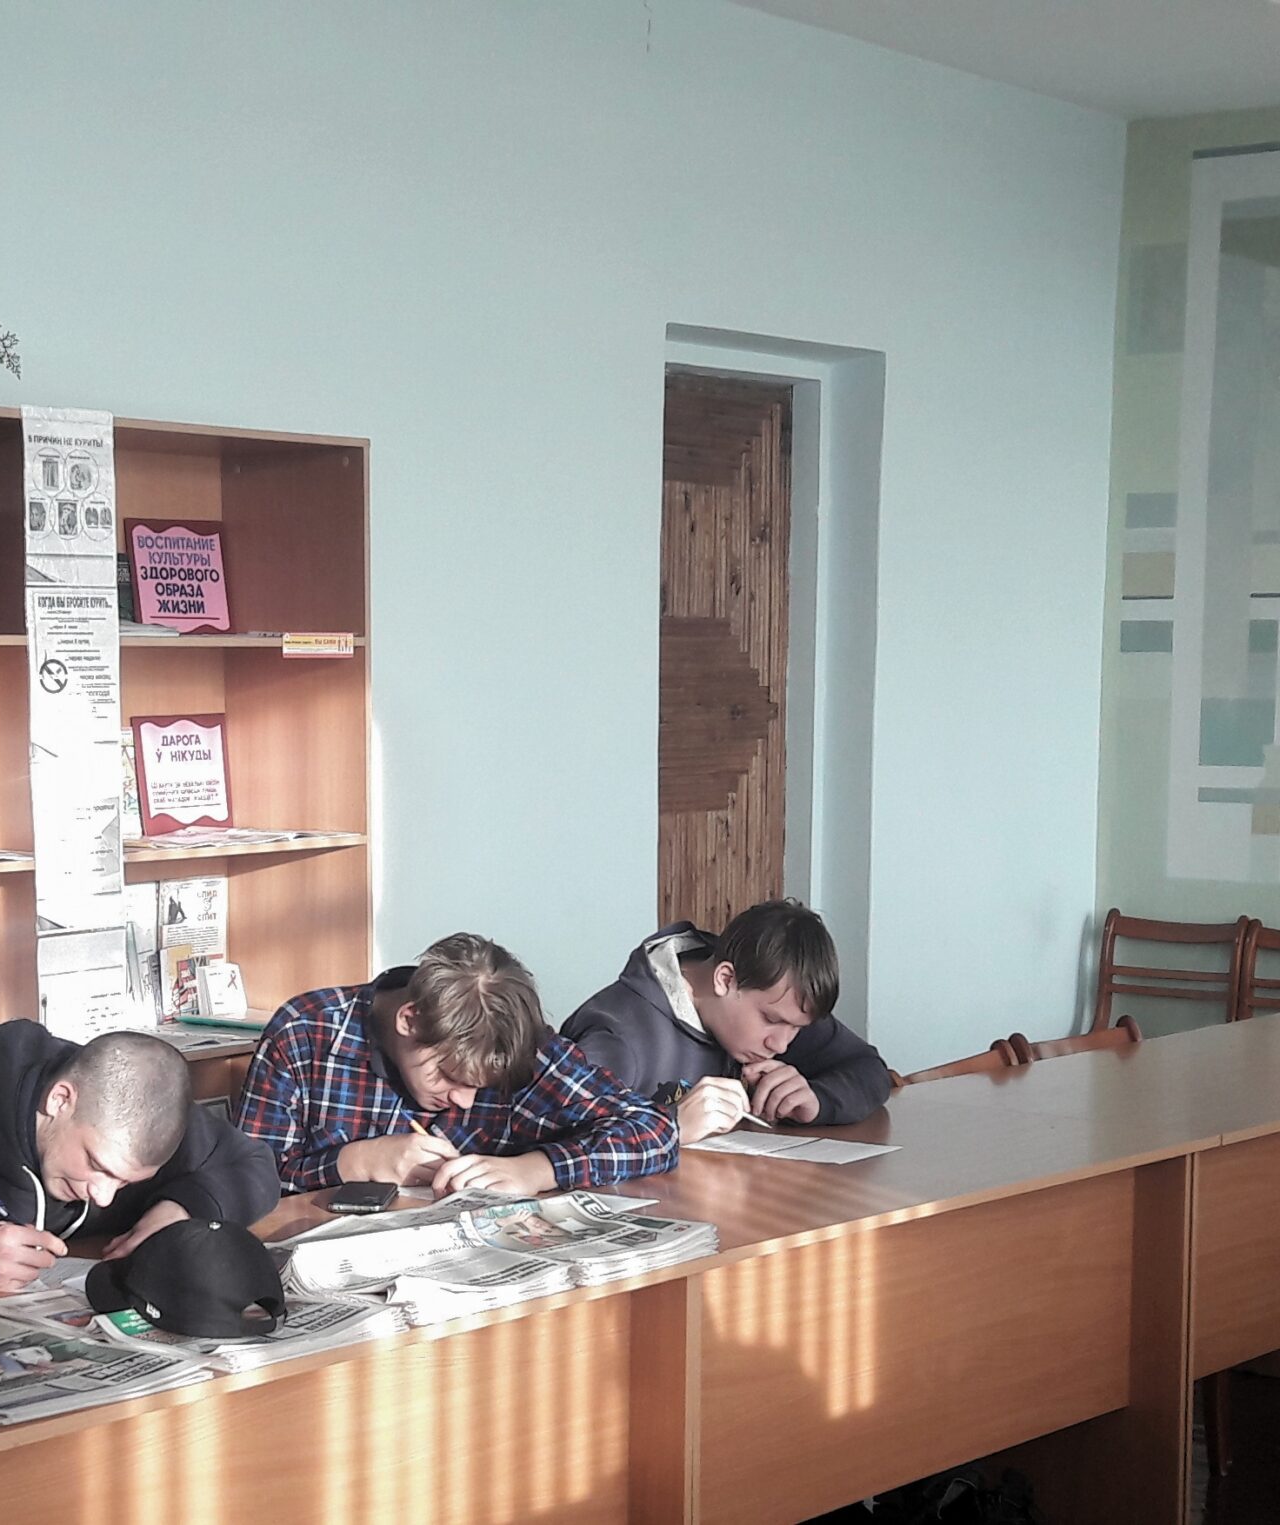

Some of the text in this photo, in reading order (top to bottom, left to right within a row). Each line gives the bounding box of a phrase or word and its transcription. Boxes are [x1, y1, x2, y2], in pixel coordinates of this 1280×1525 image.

[34, 435, 62, 446] ПРИЧИН
[137, 535, 216, 552] ВОСПИТАНИЕ
[148, 551, 211, 567] КУЛЬТУРЫ
[140, 566, 220, 582] ЗДОРОВОГО
[154, 583, 204, 599] ОБРАЗА
[157, 599, 206, 615] ЖИЗНИ
[161, 734, 202, 747] ДАРОГА
[155, 748, 162, 763] Ў
